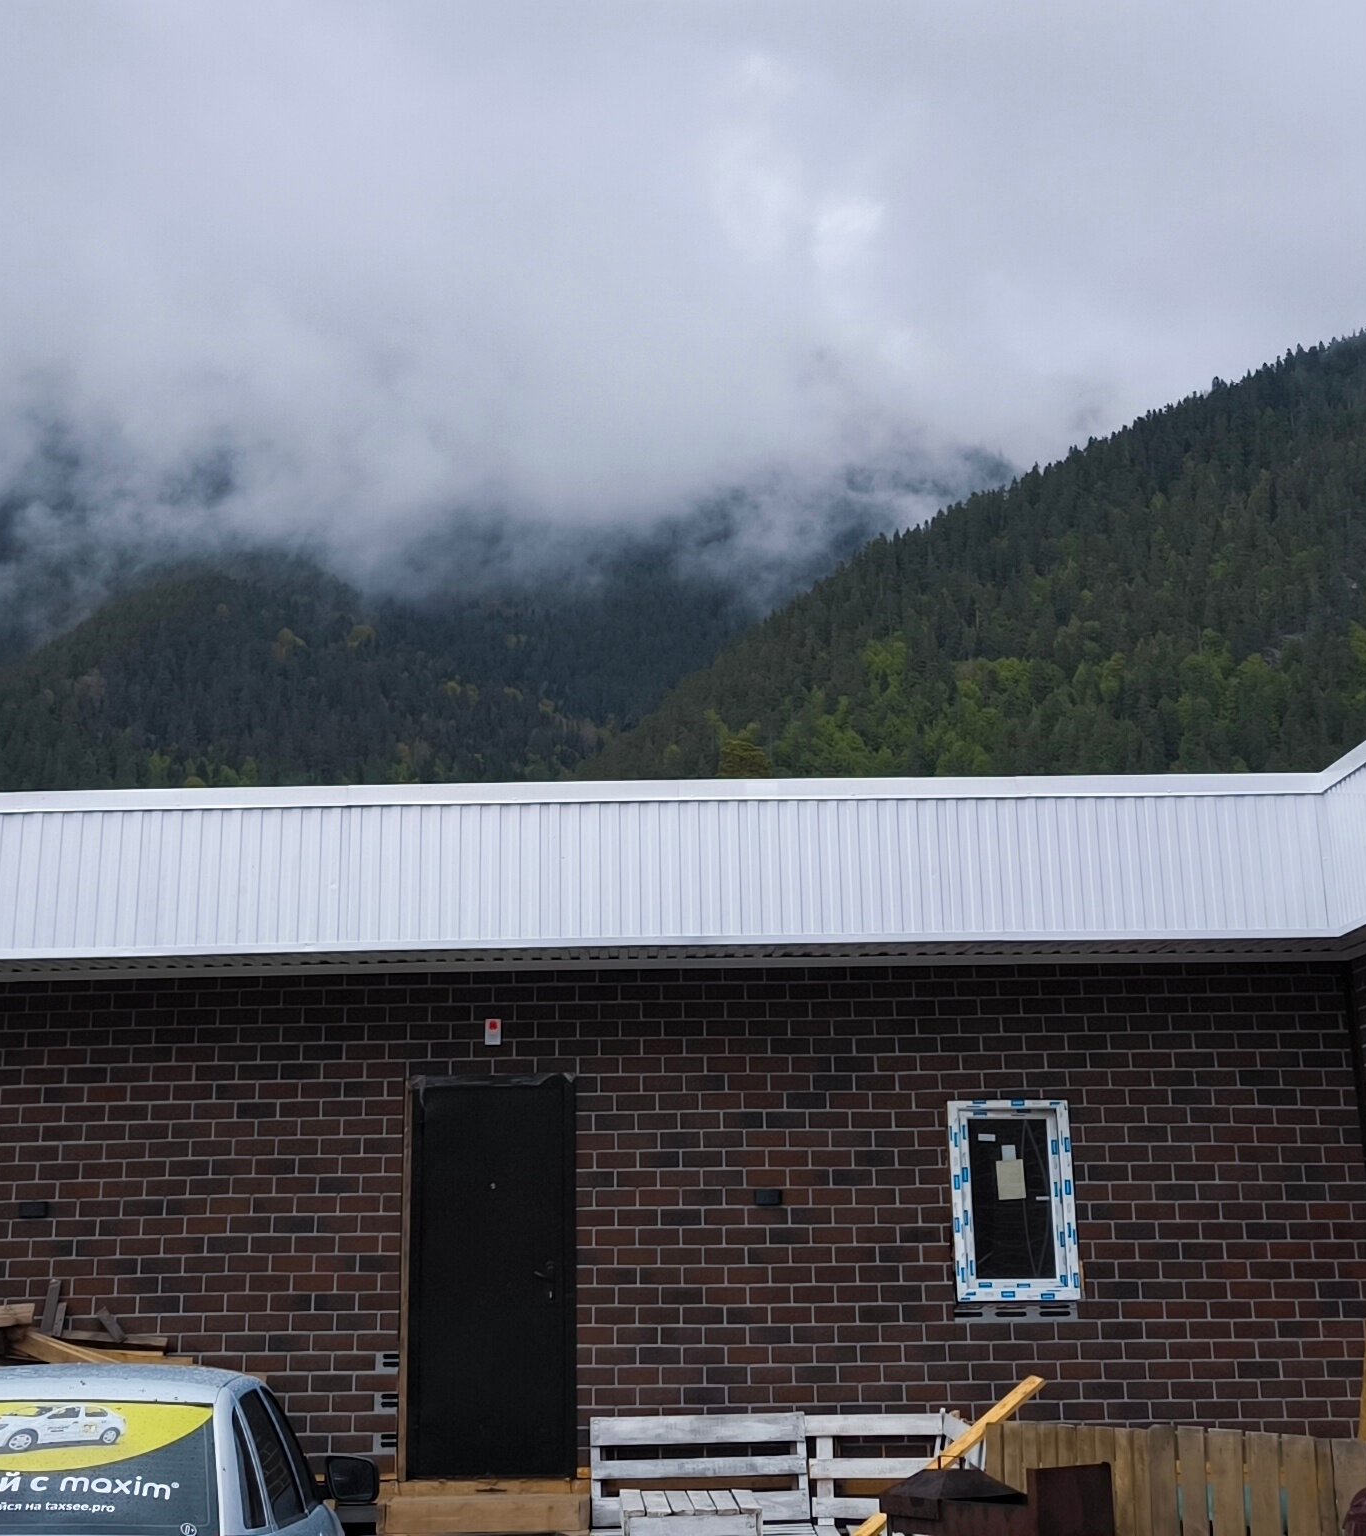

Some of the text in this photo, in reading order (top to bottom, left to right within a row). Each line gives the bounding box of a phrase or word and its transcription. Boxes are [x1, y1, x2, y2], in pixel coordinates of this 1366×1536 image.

[30, 1476, 49, 1492] с
[25, 1503, 42, 1512] на
[45, 1501, 115, 1514] taxsee.pro
